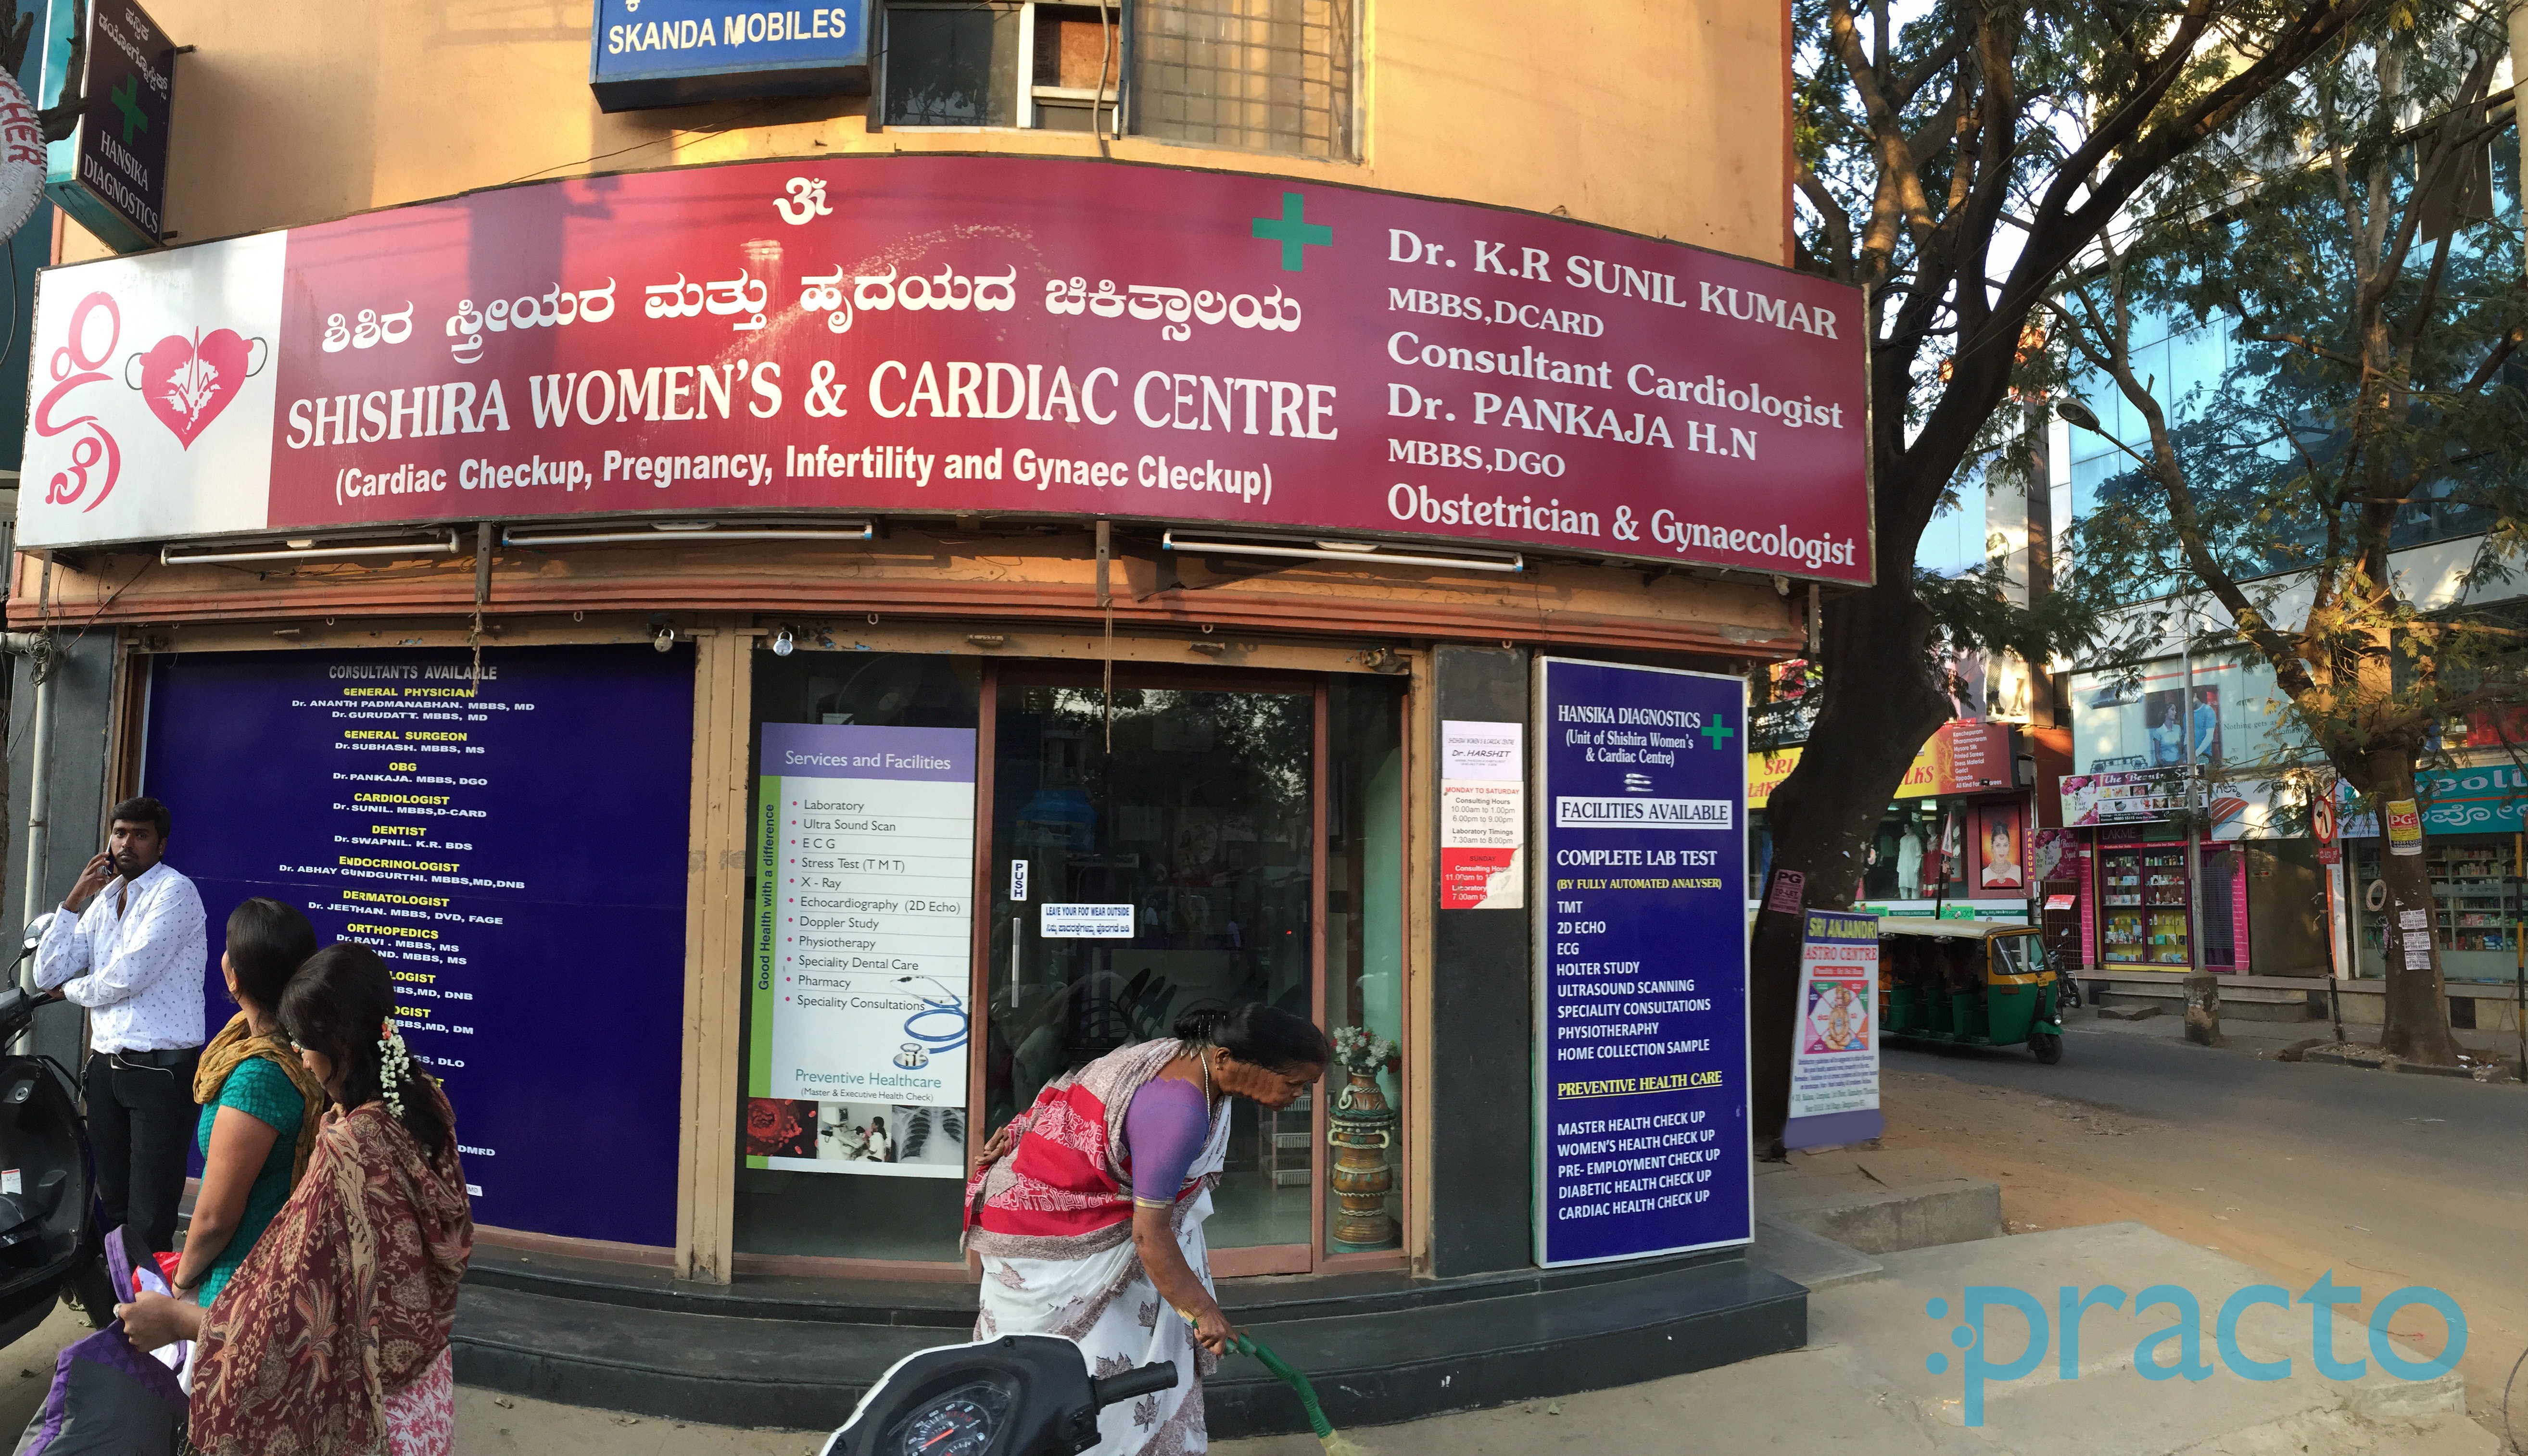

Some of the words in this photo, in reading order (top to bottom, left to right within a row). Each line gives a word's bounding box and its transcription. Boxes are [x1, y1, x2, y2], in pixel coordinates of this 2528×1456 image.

[608, 18, 716, 54] SKANDA
[724, 8, 846, 48] MOBILES
[101, 130, 149, 191] HANSIKA
[84, 153, 158, 234] DIAGNOSTICS
[1389, 229, 1456, 267] Dr.
[1474, 240, 1552, 282] K.R
[1566, 256, 1686, 307] SUNIL
[1699, 281, 1838, 339] KUMAR
[1388, 288, 1604, 337] MBBS,DCARD
[1388, 331, 1612, 389] Consultant
[1627, 364, 1843, 428] Cardiologist
[287, 379, 510, 449] SHISHIRA
[529, 358, 782, 428] WOMEN'S
[804, 360, 847, 417] &
[869, 361, 1118, 425] CARDIAC
[1134, 371, 1338, 440] CENTRE
[1388, 383, 1455, 421] Dr.
[1473, 392, 1674, 448] PANKAJA
[1687, 421, 1757, 460] H.N
[1388, 439, 1565, 477] MBBS,DGO
[336, 464, 446, 505] (Cardiac
[462, 455, 592, 491] Checkup,
[604, 450, 772, 488] Pregnancy,
[786, 445, 935, 487] Infertility
[944, 448, 1002, 479] and
[1013, 448, 1128, 490] Gynaec
[1388, 483, 1600, 536] Obstetrician
[1613, 505, 1640, 541] &
[1651, 509, 1855, 568] Gynaecologist
[404, 686, 476, 697] PHYSICIAN
[468, 703, 509, 711] MBBS,
[1558, 705, 1615, 723] HANSIKA
[1618, 708, 1700, 728] DIAGNOSTICS
[2224, 722, 2251, 731] Nothing
[2254, 720, 2267, 728] gets
[1566, 729, 1591, 747] (Unit
[1594, 730, 1605, 744] of
[1607, 730, 1647, 746] Shishira
[1650, 732, 1694, 749] Women's
[1953, 736, 1987, 745] Dharamavaram
[786, 751, 847, 766] Services
[853, 753, 880, 766] and
[886, 754, 950, 769] Facilities
[1586, 748, 1595, 762] &
[1598, 748, 1636, 763] Cardiac
[1639, 749, 1674, 767] Centre)
[390, 763, 417, 771] OBG
[1764, 759, 1793, 776] SRI
[354, 793, 450, 804] CARDIOLOGIST
[804, 800, 864, 814] Laboratory
[1455, 797, 1490, 805] Consulting
[397, 807, 486, 817] MBBS,D-CARD
[1562, 802, 1643, 818] FACILITIES
[1649, 804, 1728, 820] AVAILABLE
[2390, 815, 2412, 825] PG
[372, 826, 427, 836] DENTIST
[804, 819, 831, 829] Ultra
[834, 819, 868, 830] Sound
[872, 821, 895, 831] Scan
[763, 804, 775, 867] difference
[340, 856, 460, 873] ENDOCRINOLOGIST
[1557, 850, 1642, 866] COMPLETE
[1647, 851, 1676, 865] LAB
[1680, 851, 1718, 866] TEST
[297, 866, 337, 874] ABHAY
[341, 867, 427, 881] GUNDGURTHI.
[431, 876, 525, 889] MBBS,MD,DNB
[1014, 864, 1023, 897] PUSH
[1557, 879, 1574, 891] (BY
[1577, 879, 1607, 889] FULLY
[1610, 879, 1669, 889] AUTOMATED
[1671, 879, 1721, 890] ANALYSER)
[1778, 872, 1802, 884] PG
[342, 891, 450, 908] DERMATOLOGIST
[762, 883, 772, 907] with
[800, 896, 898, 912] Echocardiography
[905, 900, 925, 913] (2D
[929, 902, 960, 915] Echo)
[1557, 901, 1583, 913] TMT
[345, 924, 438, 941] ORTHOPEDICS
[760, 912, 771, 952] Health
[799, 936, 876, 951] Physiotherapy
[1804, 946, 1837, 960] ASTRO
[1839, 947, 1877, 960] CENTRE
[799, 955, 848, 970] Speciality
[852, 957, 888, 968] Dental
[892, 959, 918, 970] Care
[758, 956, 770, 990] Good
[1558, 982, 1634, 997] ULTRASOUND
[1638, 979, 1694, 994] SCANNING
[1558, 1022, 1659, 1039] PHYSIOTHERAPHY
[796, 1068, 864, 1084] Preventive
[870, 1073, 941, 1088] Healthcare
[1557, 1079, 1636, 1096] PREVENTIVE
[1639, 1074, 1688, 1091] HEALTH
[1691, 1071, 1722, 1085] CARE
[1559, 1203, 1610, 1220] CARDIAC
[1613, 1198, 1655, 1214] HEALTH
[1657, 1192, 1692, 1208] CHECK
[1695, 1190, 1710, 1203] UP
